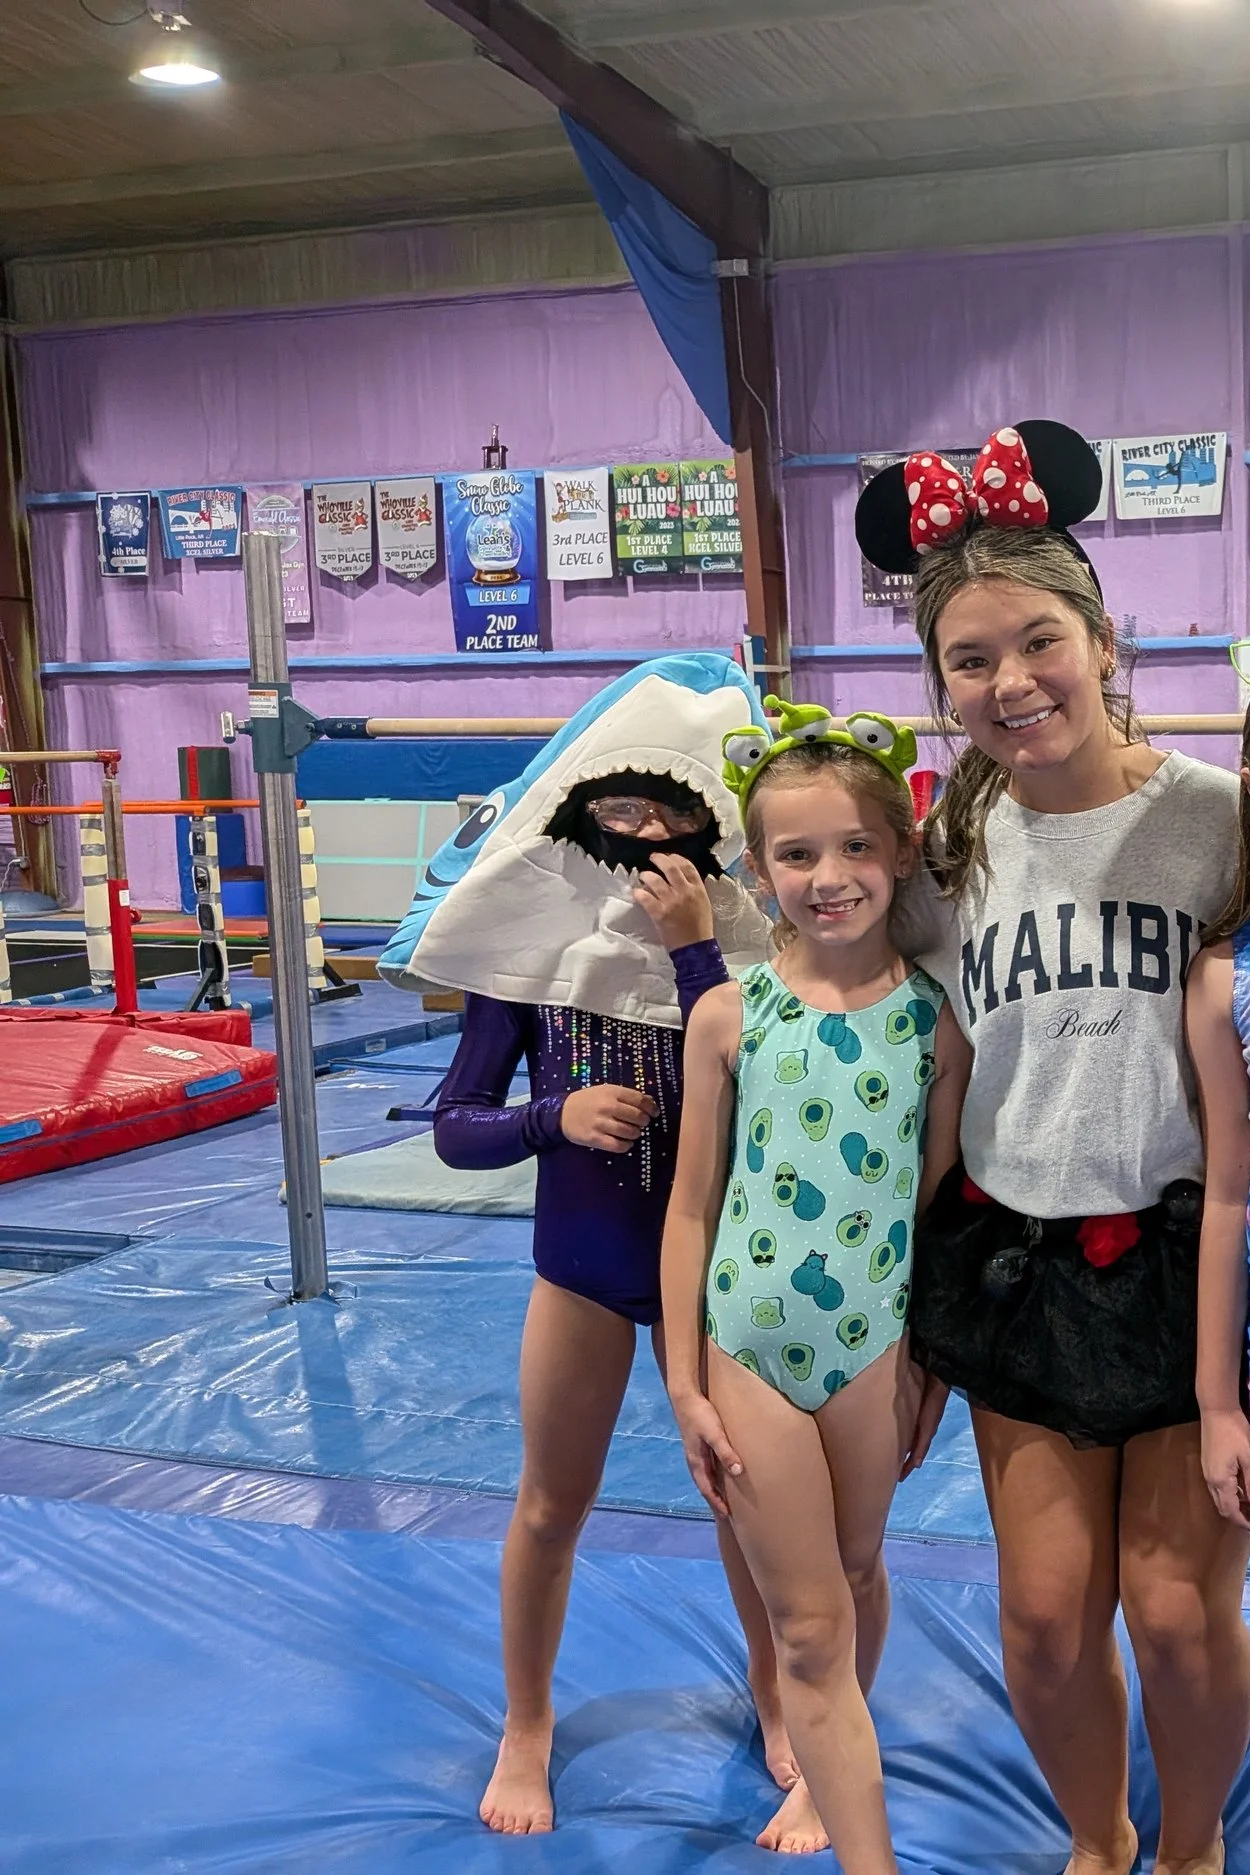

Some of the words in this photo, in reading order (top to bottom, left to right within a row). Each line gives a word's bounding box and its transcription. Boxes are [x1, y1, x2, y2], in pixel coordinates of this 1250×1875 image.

[1121, 446, 1151, 461] RIVER
[1153, 442, 1174, 456] CITY
[1178, 434, 1216, 452] CLASSIC
[642, 474, 650, 486] A
[710, 471, 718, 482] A
[457, 479, 489, 499] Snow
[490, 475, 524, 497] Globe
[564, 480, 598, 491] WALK
[617, 487, 644, 504] HUI
[647, 486, 677, 502] HOU
[684, 484, 712, 501] HUI
[167, 492, 188, 506] RIVER
[381, 497, 416, 509] WHOVILLE
[1142, 497, 1171, 506] THIRD
[1174, 496, 1200, 504] PLACE
[318, 501, 353, 512] WHOVILLE
[471, 497, 511, 516] Classic
[563, 500, 606, 512] PLANK
[629, 503, 666, 519] LUAU
[696, 500, 734, 516] LUAU
[319, 512, 351, 523] CLASSIC
[382, 508, 415, 520] CLASSIC
[553, 533, 572, 546] 3rd
[575, 532, 608, 545] PLACE
[626, 536, 641, 545] 1ST
[643, 534, 672, 545] PLACE
[694, 533, 708, 542] 1ST
[711, 532, 741, 542] PLACE
[112, 547, 124, 556] 4th
[126, 546, 145, 555] Place
[631, 546, 659, 555] LEVEL
[661, 545, 668, 555] 4
[689, 543, 712, 553] XCEL
[715, 542, 742, 552] SILVE
[321, 554, 336, 564] 3RD
[338, 553, 370, 564] PLACE
[384, 551, 400, 562] 3RD
[401, 550, 435, 560] PLACE
[559, 553, 594, 566] LEVEL
[597, 552, 604, 564] 6
[480, 590, 507, 602] LEVEL
[511, 590, 517, 600] 6
[486, 614, 517, 634] 2ND
[466, 636, 504, 650] PLACE
[507, 634, 538, 648] TEAM
[1045, 1007, 1122, 1040] Beach
